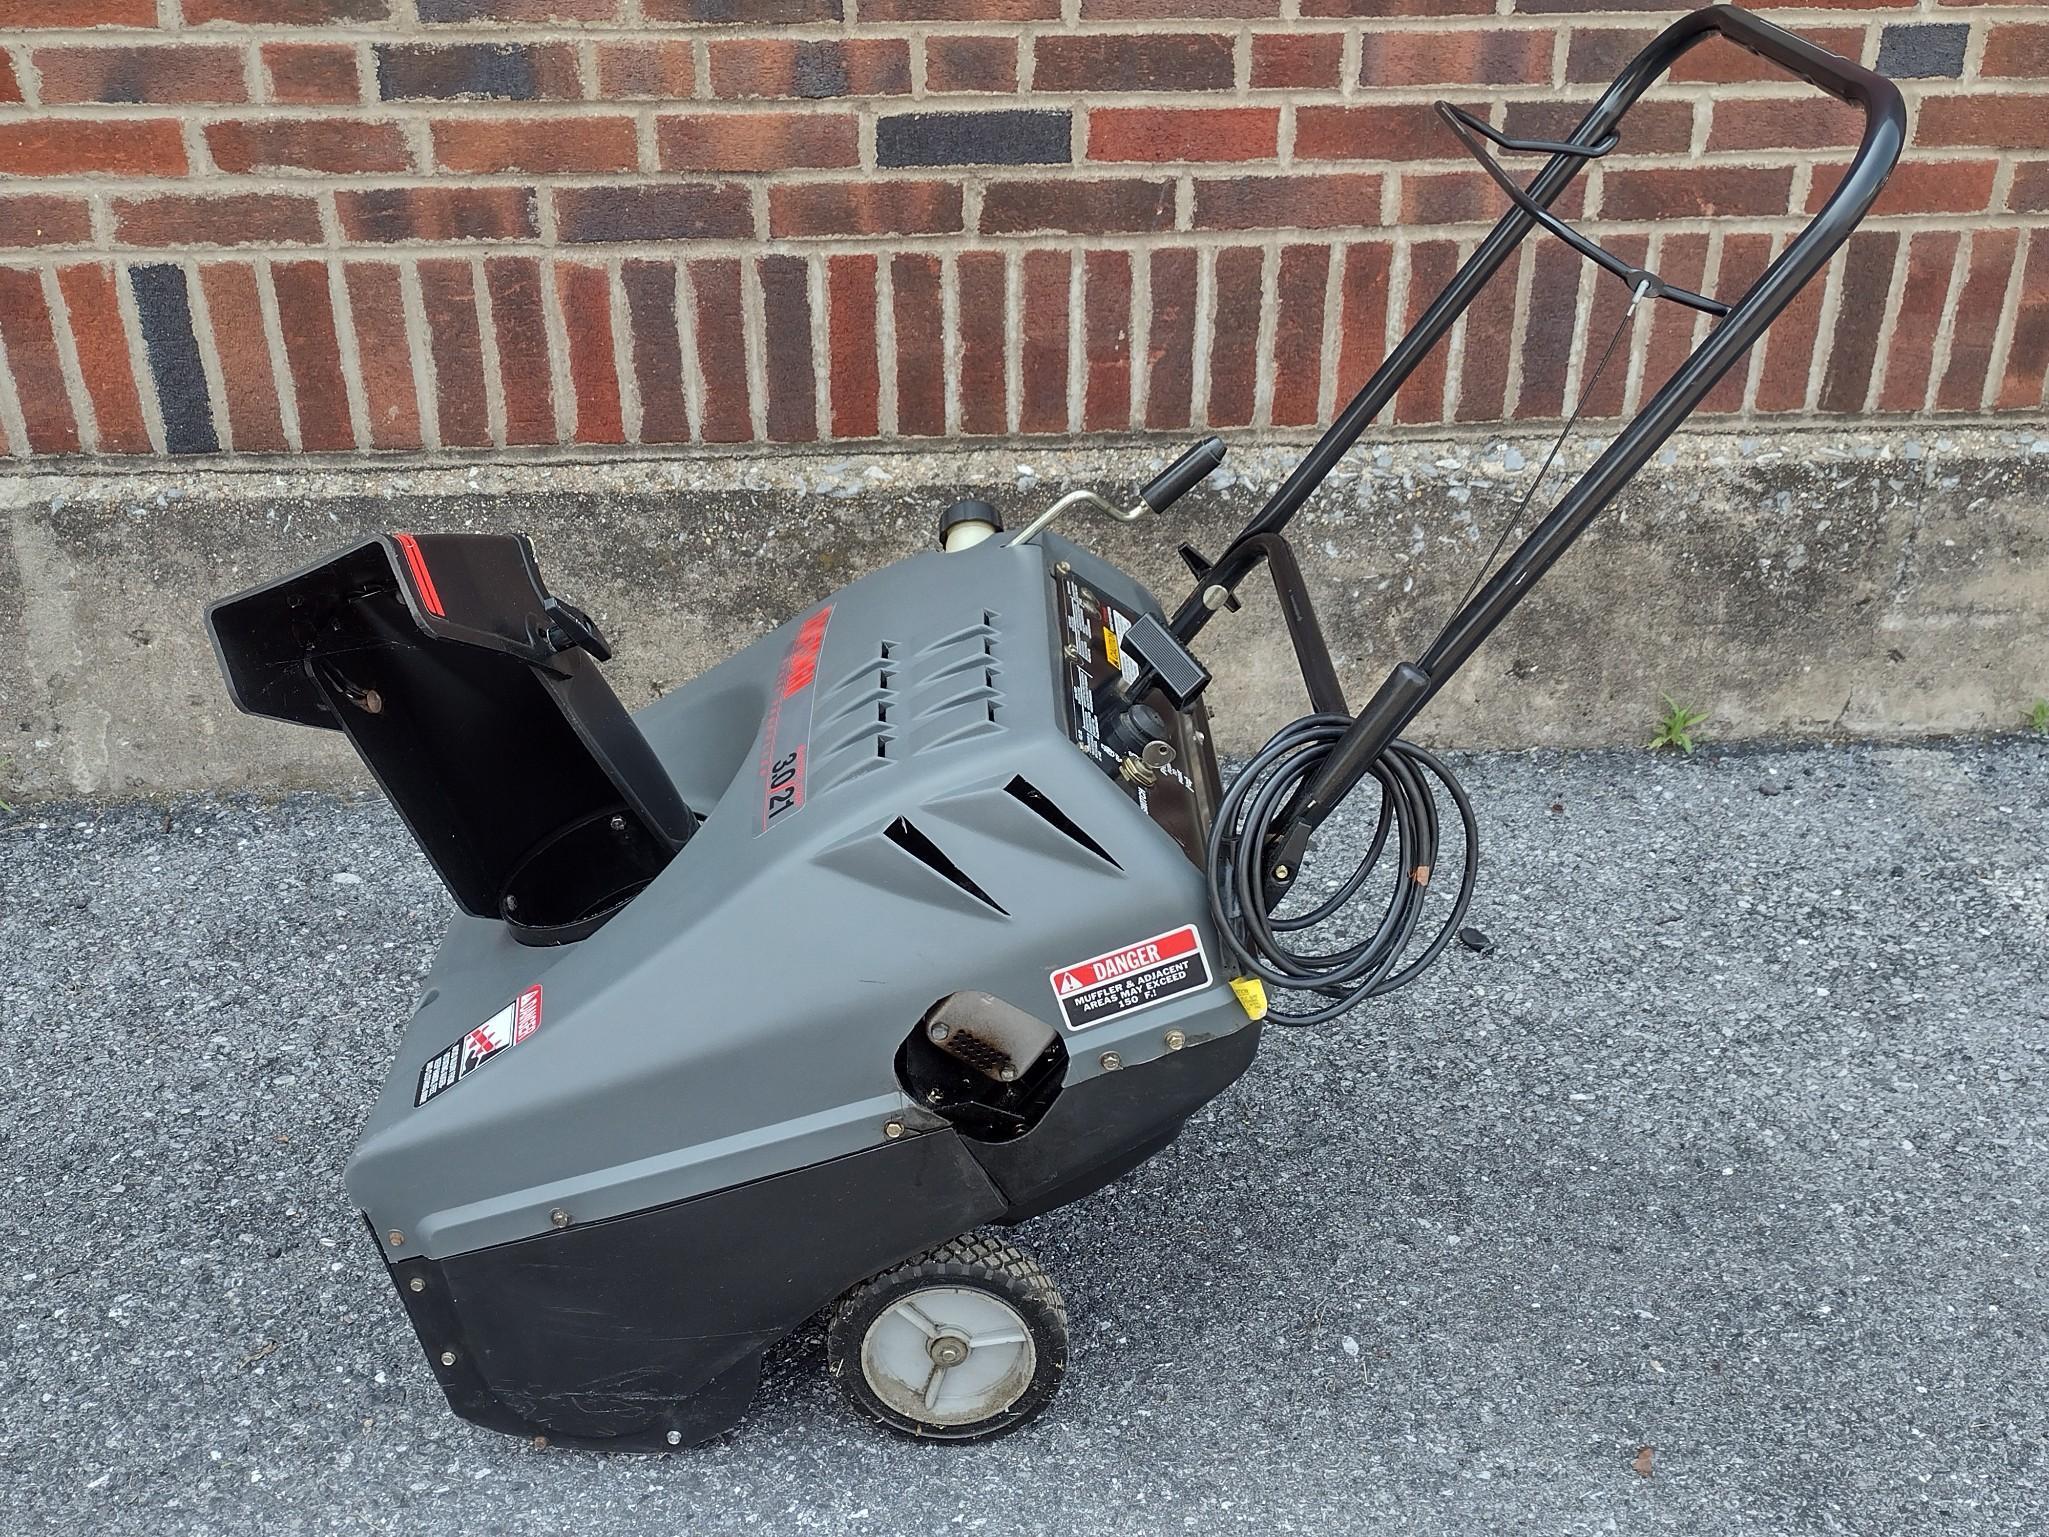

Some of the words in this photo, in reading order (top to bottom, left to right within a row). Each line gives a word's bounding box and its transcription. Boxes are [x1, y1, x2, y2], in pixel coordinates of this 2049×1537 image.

[1093, 944, 1160, 981] DANGER
[1075, 983, 1123, 1006] MUFFLER
[1126, 980, 1135, 989] &
[1138, 961, 1189, 985] ADJACENT
[1083, 994, 1118, 1012] AREAS
[1120, 985, 1143, 999] MAY
[1146, 971, 1187, 990] EXCEED
[1119, 997, 1138, 1008] 150
